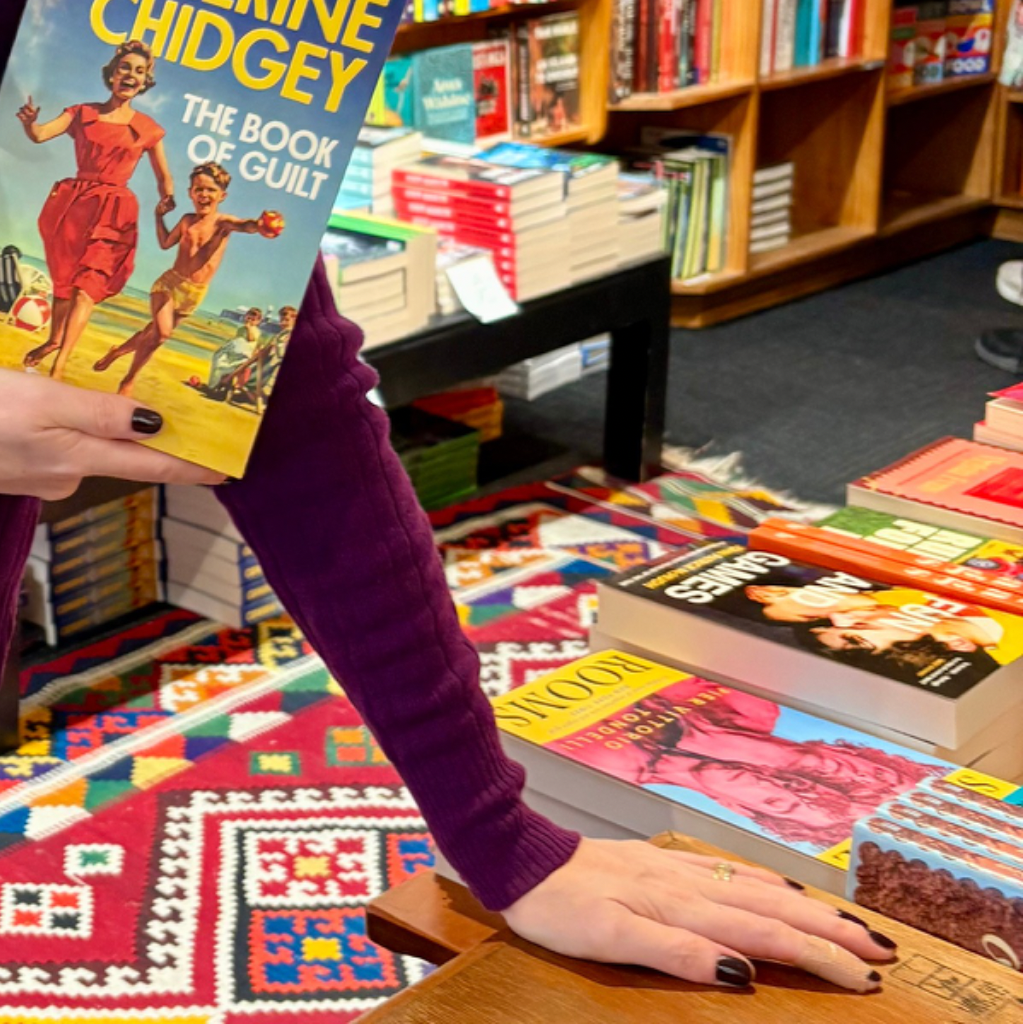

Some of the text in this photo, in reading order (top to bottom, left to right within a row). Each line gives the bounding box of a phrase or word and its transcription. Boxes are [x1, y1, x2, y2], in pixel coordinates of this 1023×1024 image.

[182, 93, 339, 169] THE BOOK
[187, 134, 330, 201] OF GUILT
[664, 550, 792, 604] GAMES
[790, 571, 872, 609] AND
[878, 593, 968, 634] FUN
[495, 655, 654, 728] ROOMS
[559, 707, 653, 750] TONDELLI
[603, 705, 692, 750] VITTORIO
